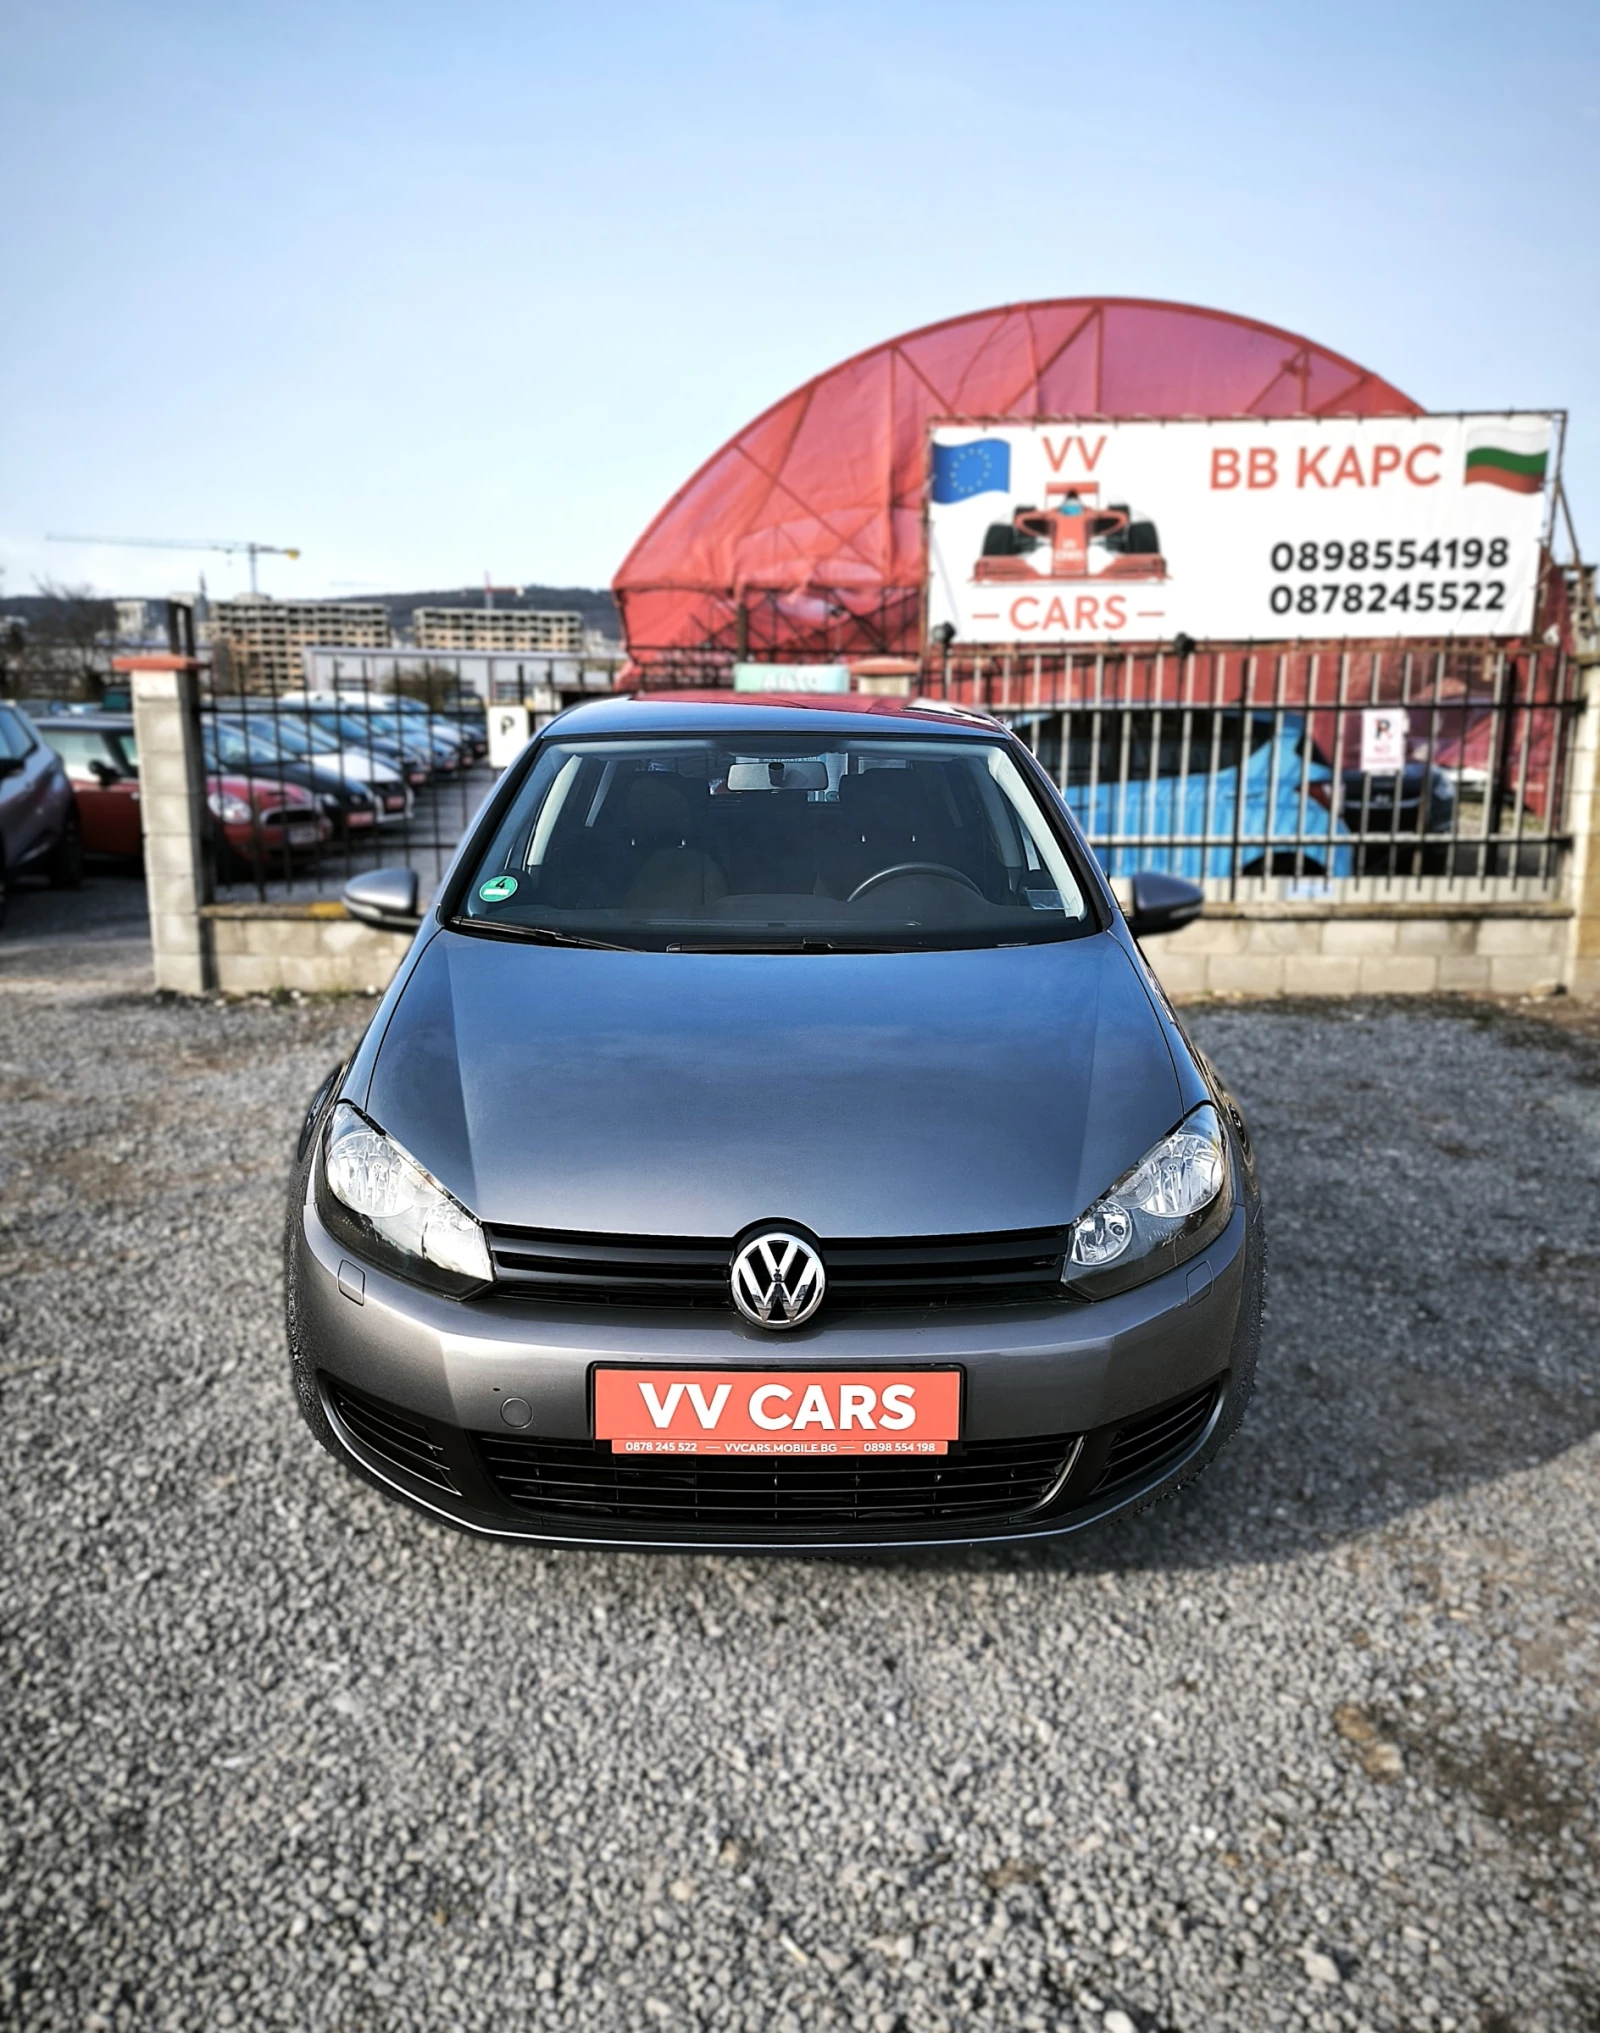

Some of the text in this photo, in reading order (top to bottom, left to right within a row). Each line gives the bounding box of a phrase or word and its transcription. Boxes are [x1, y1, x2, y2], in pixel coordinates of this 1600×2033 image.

[1042, 435, 1107, 473] VV
[1296, 443, 1443, 489] КАРС
[1270, 537, 1510, 573] 0898554198
[1009, 595, 1127, 631] CARS
[1269, 580, 1507, 616] 0878245522
[495, 877, 507, 889] 4
[733, 1234, 824, 1328] VW
[637, 1382, 917, 1431] VV CARS
[625, 1441, 936, 1453] 0878 245 522 VVCARS.MOBILE.BG 0898 554 198
